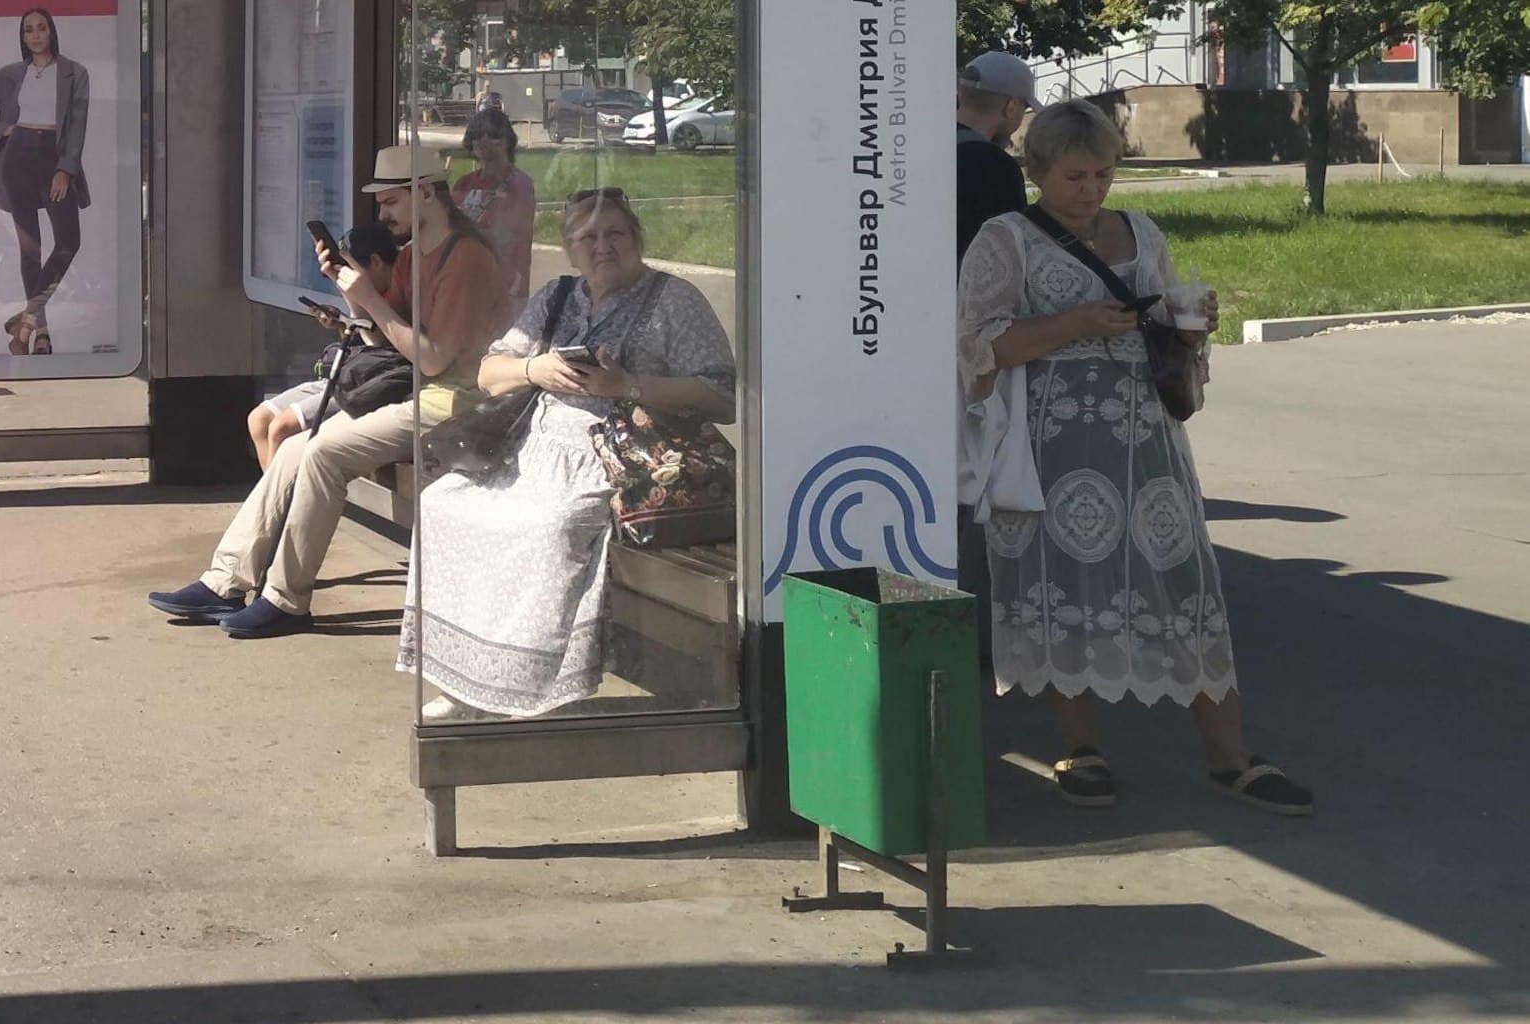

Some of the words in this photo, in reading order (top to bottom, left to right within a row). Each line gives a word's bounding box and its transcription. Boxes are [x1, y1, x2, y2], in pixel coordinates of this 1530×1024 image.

[852, 18, 885, 179] Дмитрия
[888, 55, 906, 126] Bulvar
[888, 133, 906, 206] Metro
[852, 189, 885, 356] «Бульвар
